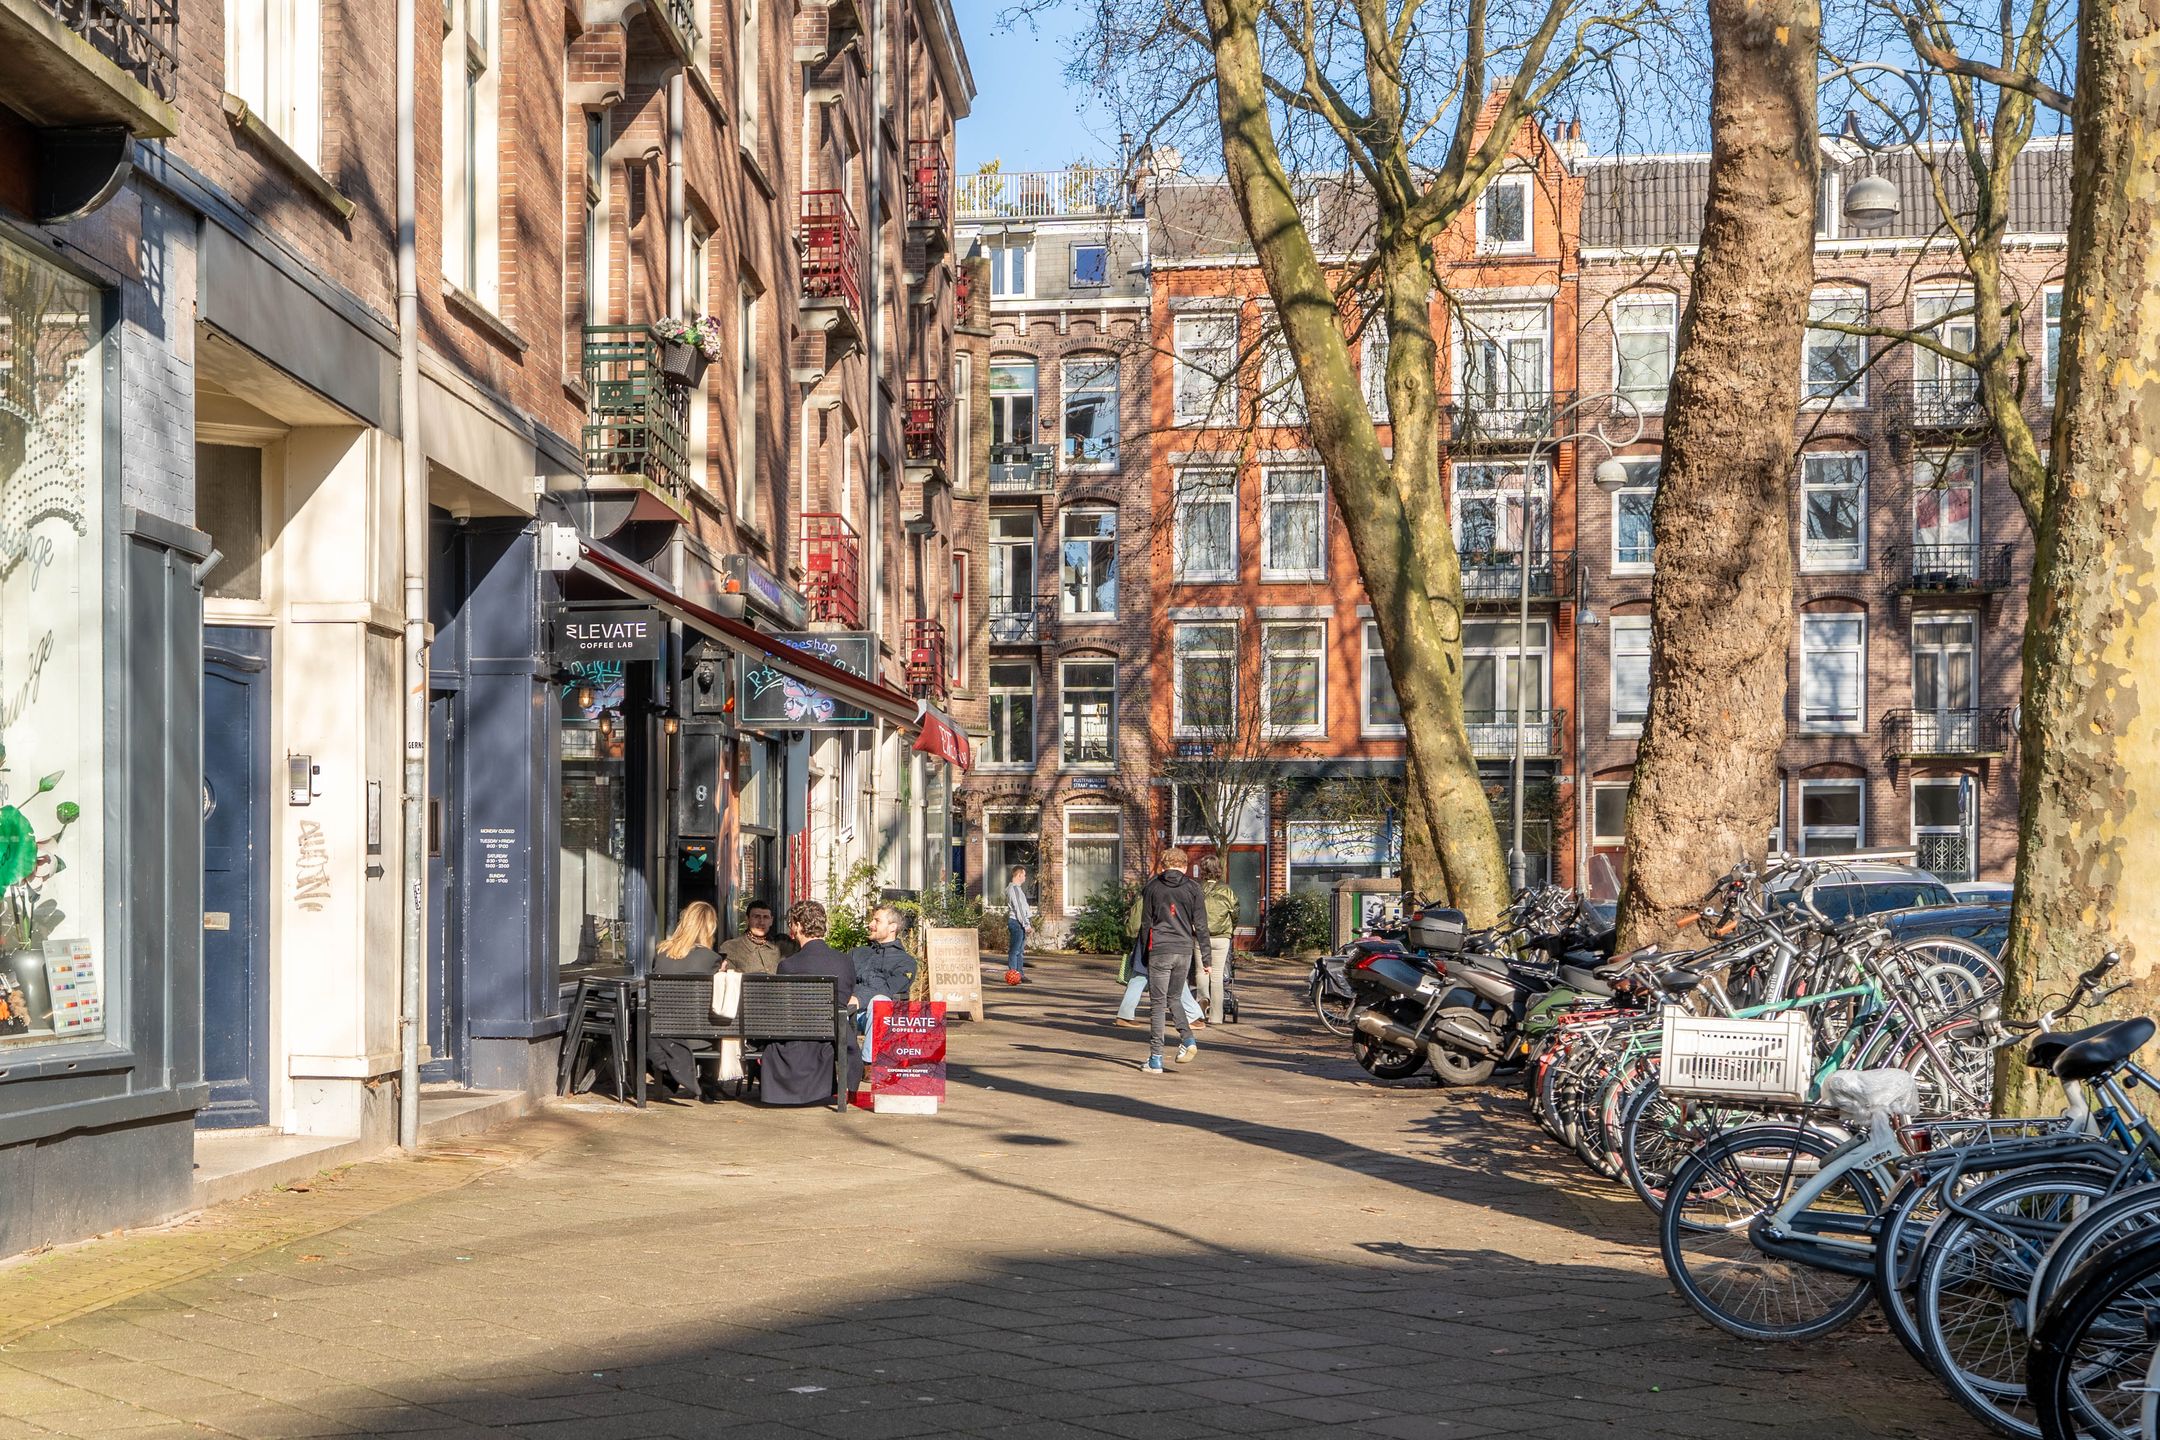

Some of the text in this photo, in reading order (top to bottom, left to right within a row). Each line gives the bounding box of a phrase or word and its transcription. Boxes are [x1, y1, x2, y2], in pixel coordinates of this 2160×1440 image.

[695, 785, 707, 802] 8
[936, 973, 975, 985] BROOD
[896, 1048, 922, 1056] OPEN
